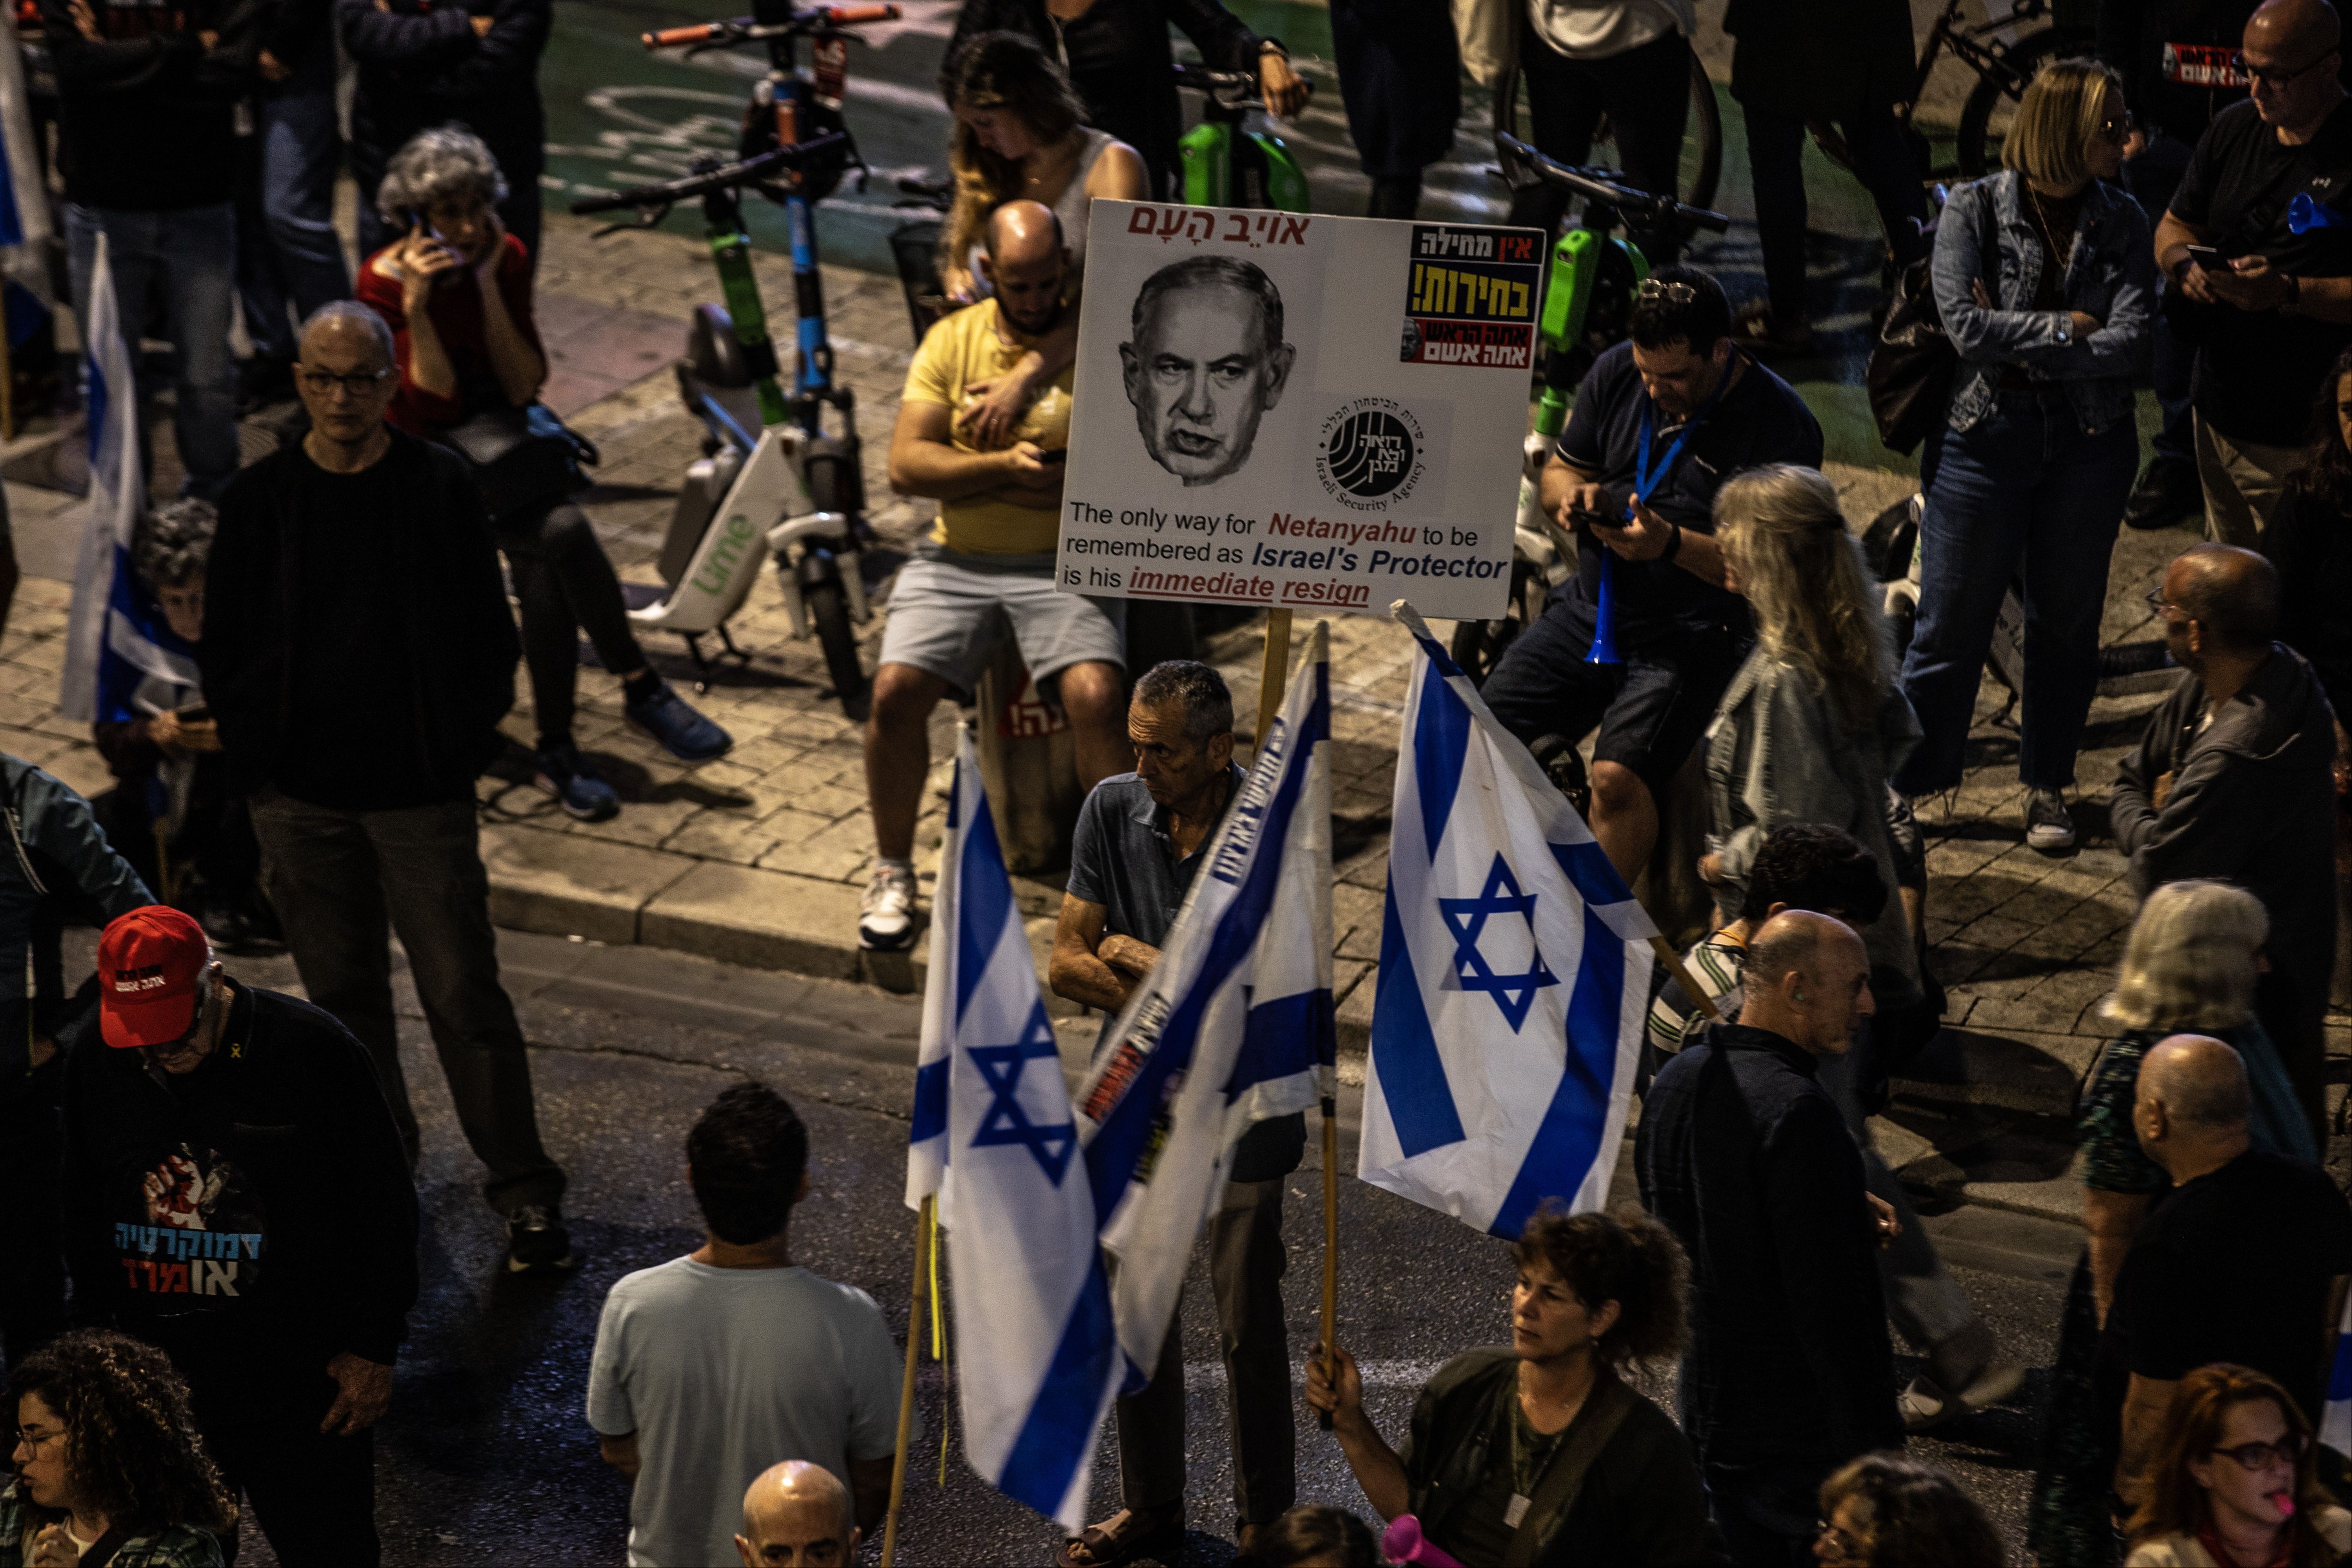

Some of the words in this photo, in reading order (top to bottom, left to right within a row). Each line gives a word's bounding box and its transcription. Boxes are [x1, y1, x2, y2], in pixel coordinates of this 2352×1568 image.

[1420, 227, 1493, 258] מחילה
[1498, 236, 1533, 262] אין
[1412, 263, 1529, 318] בחירות!
[1426, 321, 1482, 343] הראש
[1485, 325, 1527, 345] אתה
[1423, 341, 1480, 363] אשם
[1482, 345, 1527, 366] אתה
[1316, 457, 1338, 495] Israeli
[1336, 492, 1387, 512] Security
[1392, 462, 1426, 503] Agency
[1070, 501, 1113, 524] The
[1120, 507, 1167, 532] only
[1175, 513, 1220, 536] way
[1225, 513, 1256, 535] for
[1268, 512, 1417, 546] Netanyahu
[1423, 528, 1443, 545] to
[1451, 527, 1478, 546] be
[1066, 536, 1211, 562] remembered
[1217, 547, 1243, 564] as
[1252, 541, 1358, 572] Israel's
[1368, 550, 1508, 579] Protector
[1064, 565, 1082, 585] is
[1089, 566, 1122, 588] his
[1129, 566, 1275, 597] immediate
[1282, 578, 1370, 607] resign
[114, 1222, 262, 1262] דמוקרטיה
[120, 1256, 190, 1293] מרד
[191, 1259, 241, 1297] או
